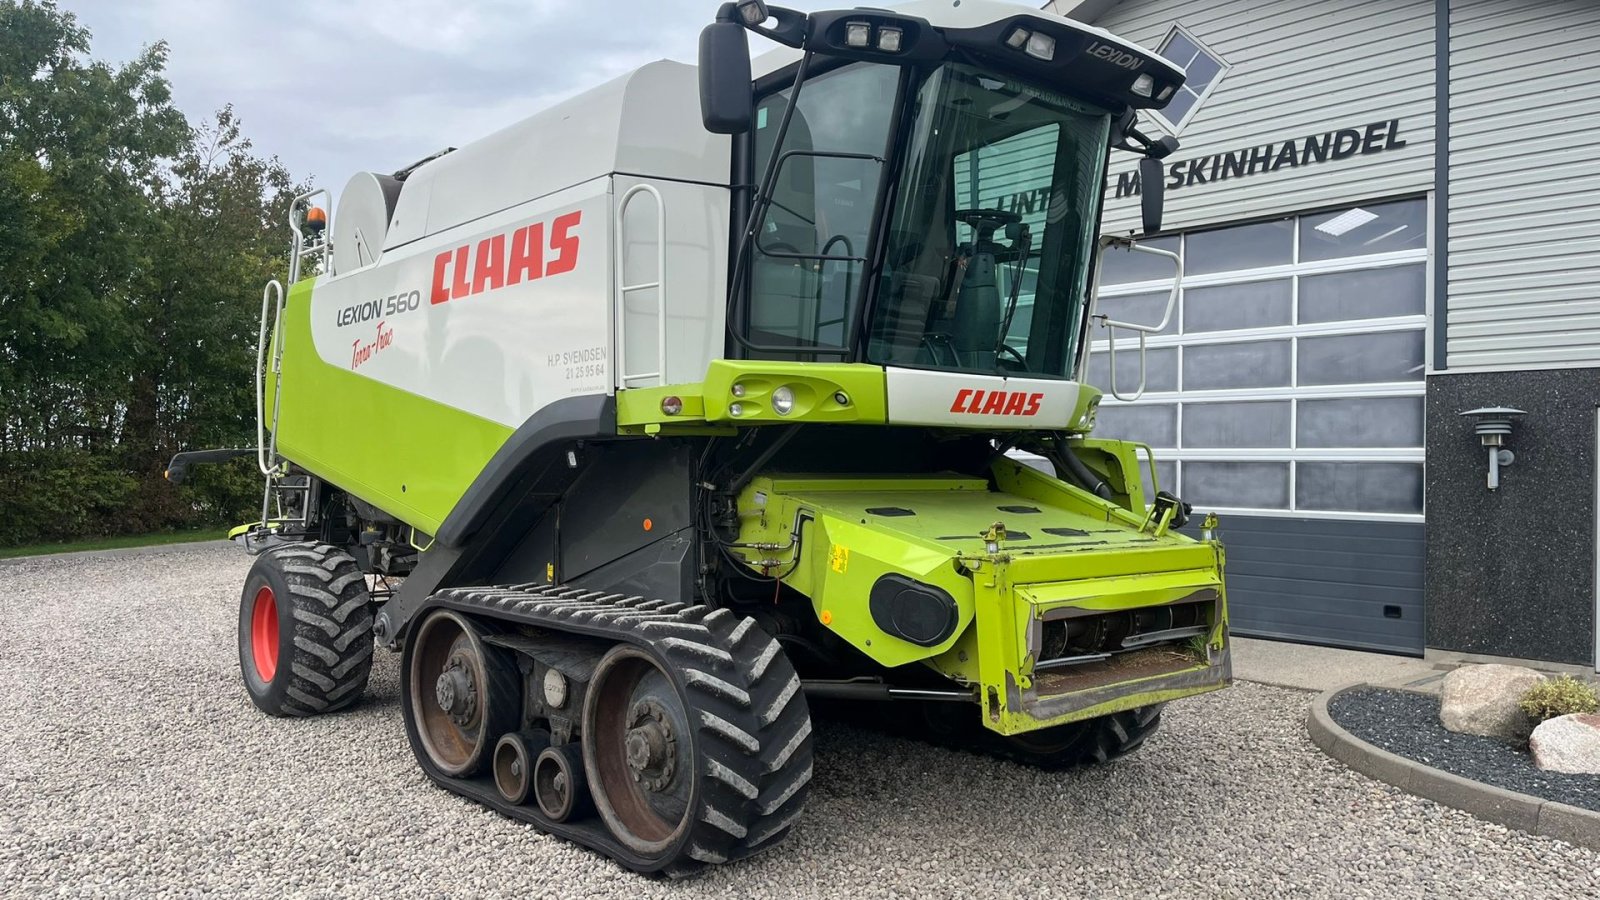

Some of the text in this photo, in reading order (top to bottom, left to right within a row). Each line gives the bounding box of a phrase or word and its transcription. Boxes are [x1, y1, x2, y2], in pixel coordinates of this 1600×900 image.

[1086, 41, 1145, 70] LEXION
[1116, 119, 1407, 199] MSKINHANDEL
[430, 210, 581, 305] CLAAS
[336, 289, 420, 328] LEXION 560
[351, 320, 394, 370] Terra-Trac
[563, 346, 607, 366] SVENDSEN
[566, 363, 604, 380] 21 25 95 64
[950, 389, 1045, 416] CLAAS
